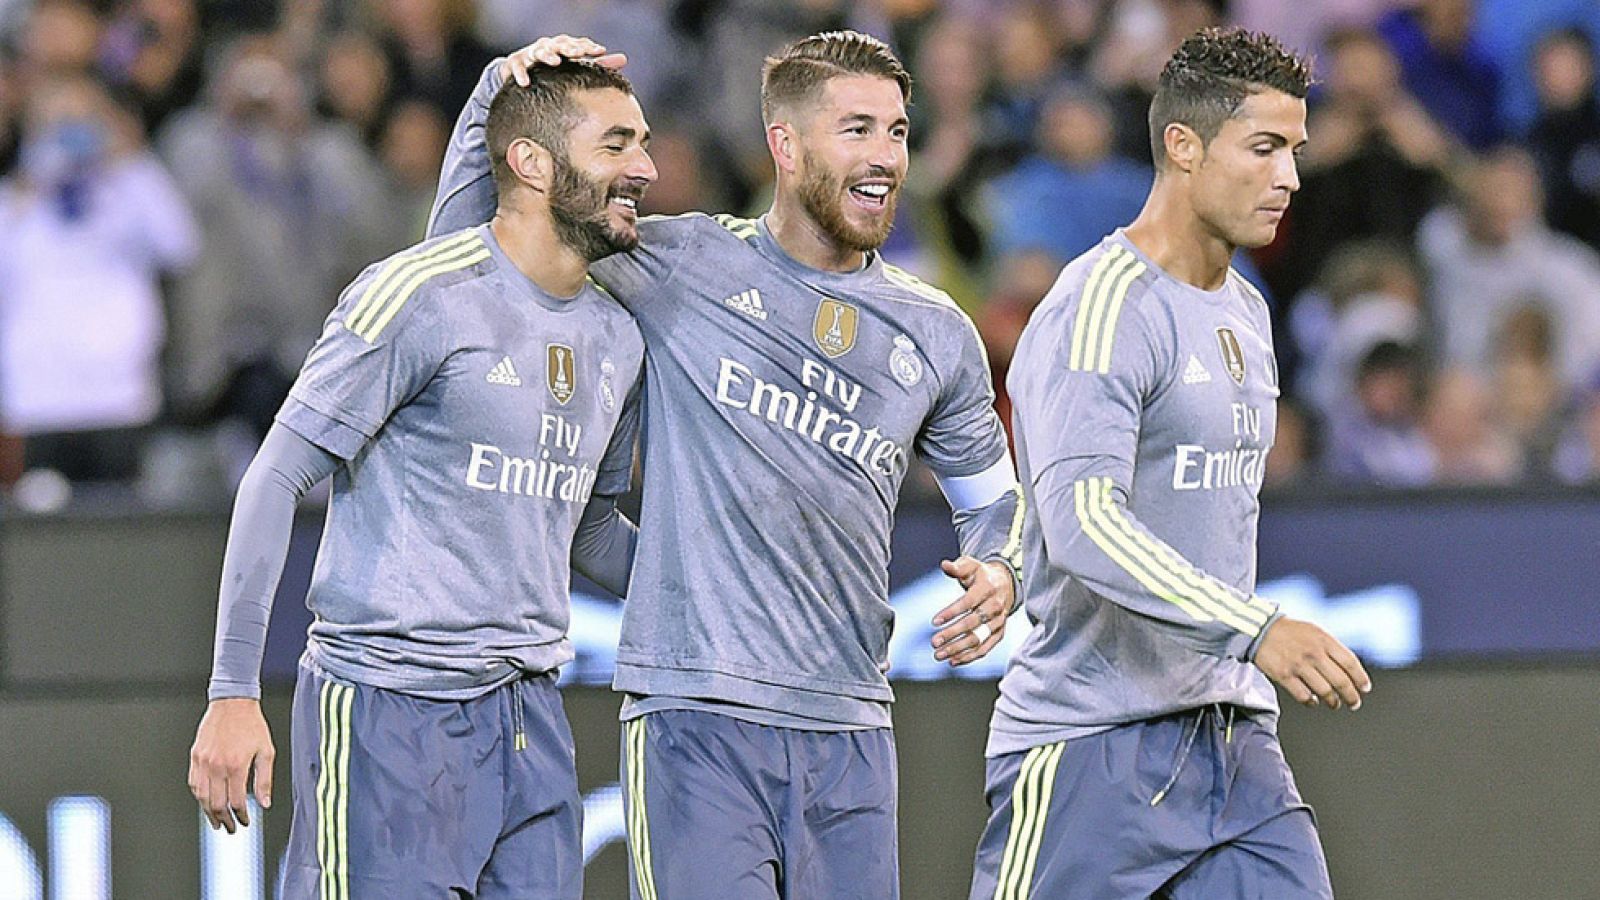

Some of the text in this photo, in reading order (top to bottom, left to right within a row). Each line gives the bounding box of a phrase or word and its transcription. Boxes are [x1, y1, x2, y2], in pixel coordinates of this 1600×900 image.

[802, 359, 862, 412] Fly
[540, 414, 581, 457] Fly
[717, 358, 902, 475] Emirates
[1231, 403, 1260, 441] Fly
